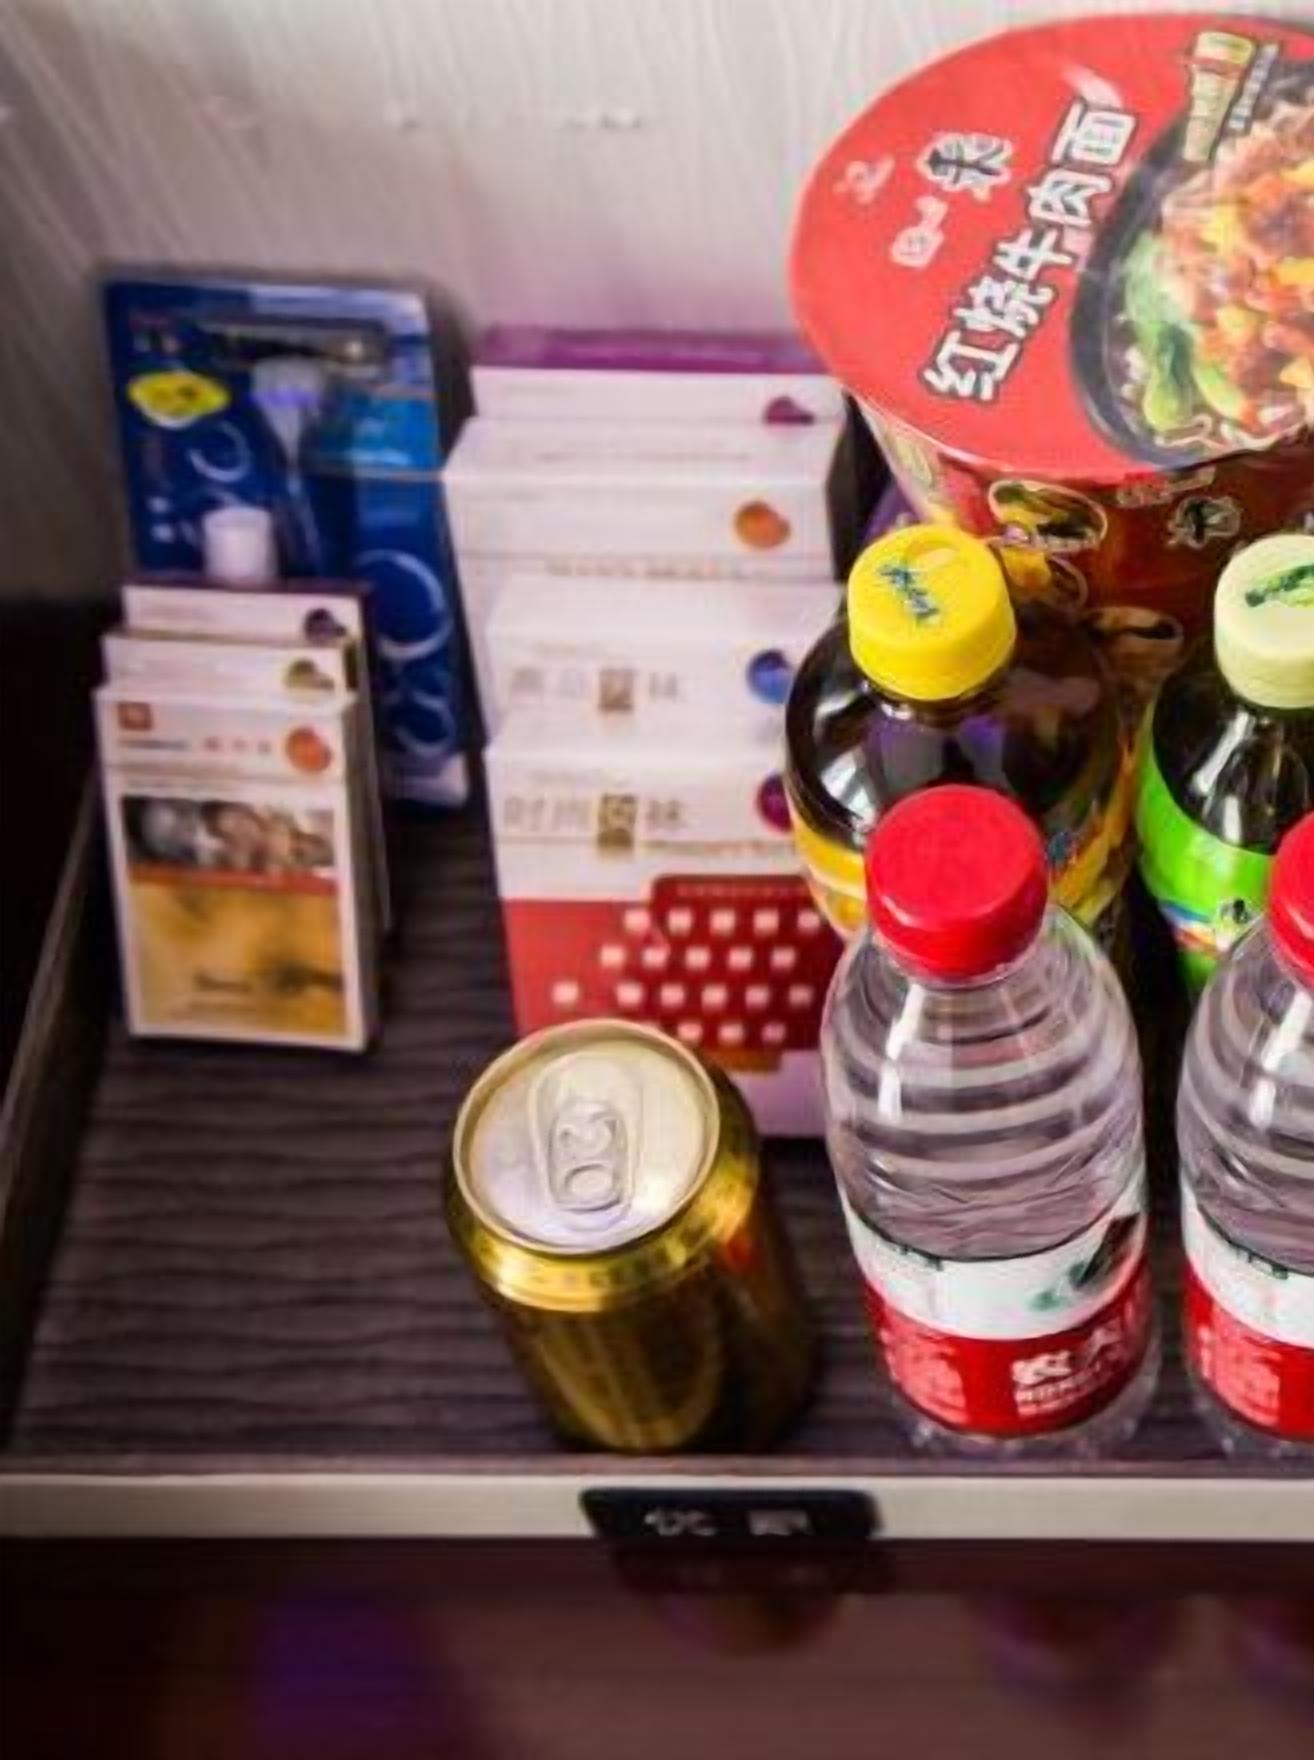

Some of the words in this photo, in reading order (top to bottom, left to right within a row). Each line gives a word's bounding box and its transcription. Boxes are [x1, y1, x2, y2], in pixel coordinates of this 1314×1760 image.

[921, 104, 1135, 399] 红烧牛肉面
